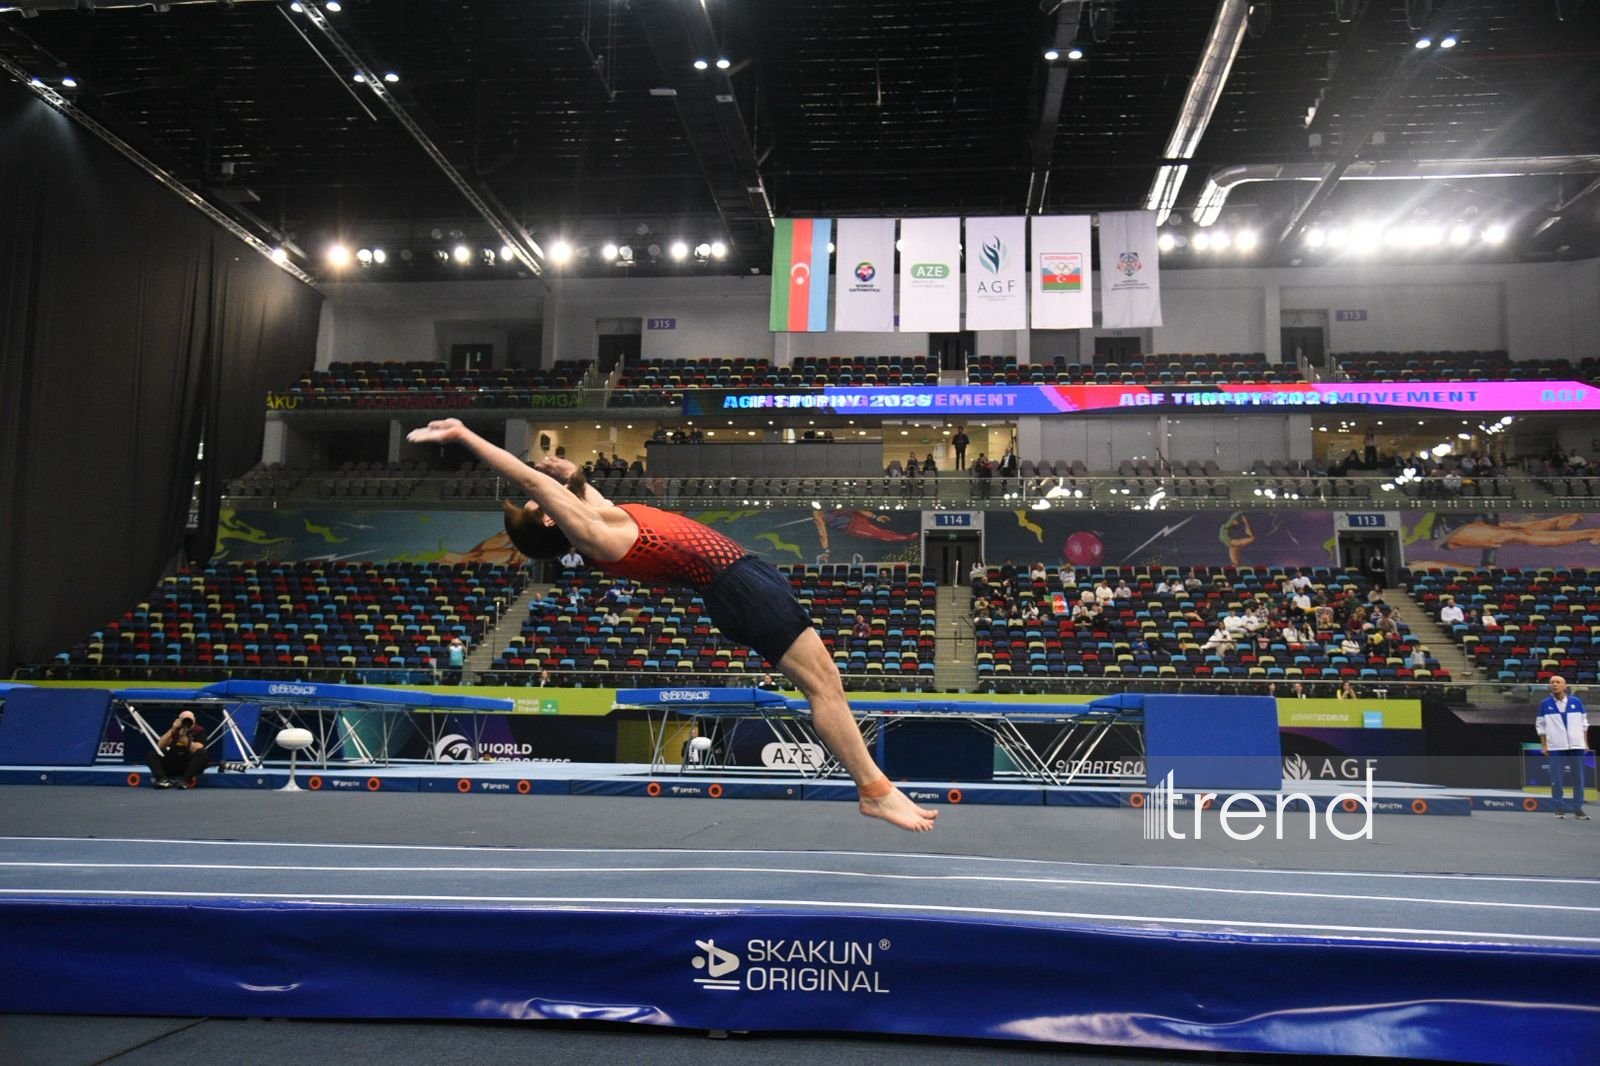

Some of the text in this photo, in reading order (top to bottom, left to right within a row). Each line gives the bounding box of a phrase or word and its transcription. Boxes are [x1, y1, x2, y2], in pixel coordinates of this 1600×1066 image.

[916, 266, 943, 277] AZE
[977, 280, 1015, 293] AGF
[653, 320, 671, 329] 315
[1119, 393, 1164, 406] AGF
[943, 515, 963, 525] 114
[1358, 515, 1378, 526] 113
[478, 743, 533, 755] WORLD
[772, 748, 812, 764] AZE
[1320, 758, 1378, 778] AGF
[747, 939, 872, 966] SKAKUN
[746, 967, 890, 993] ORIGINAL
